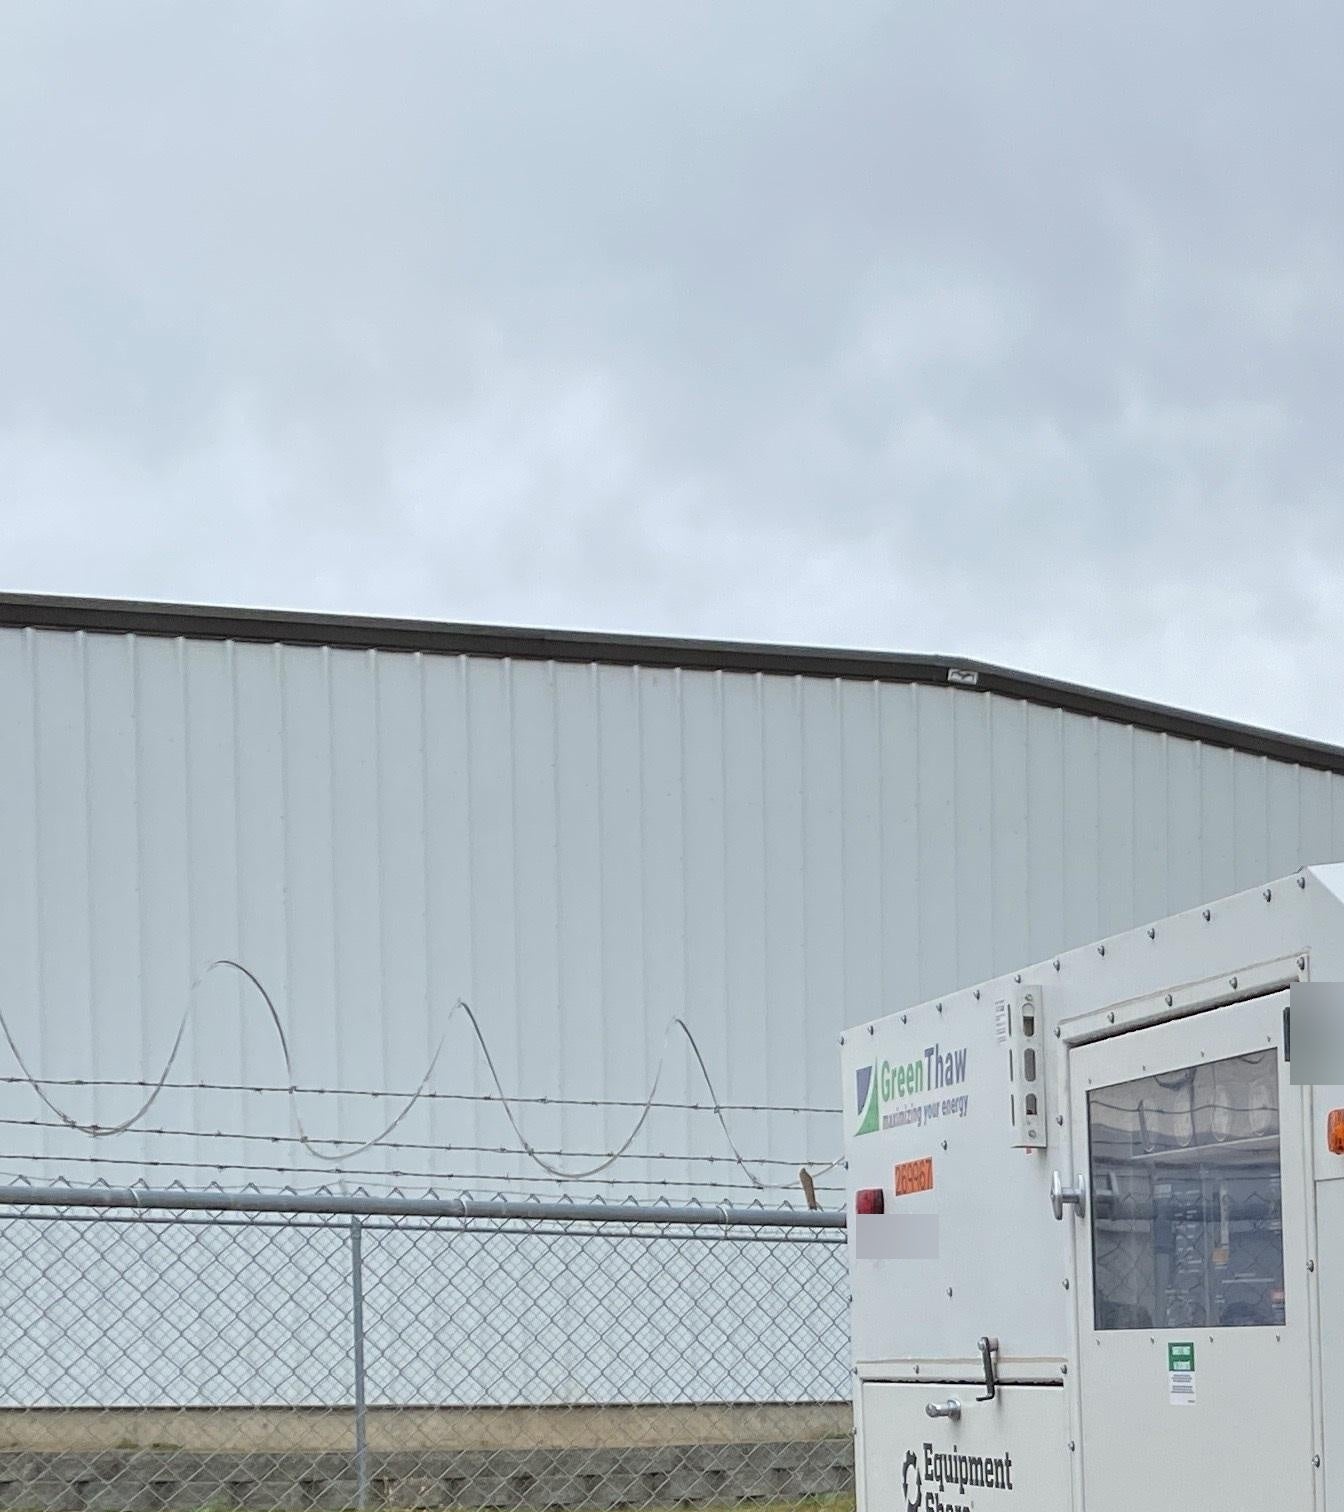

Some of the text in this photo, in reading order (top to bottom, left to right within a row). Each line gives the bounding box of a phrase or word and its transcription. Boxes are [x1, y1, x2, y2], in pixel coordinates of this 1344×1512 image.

[923, 1101, 940, 1126] your
[942, 1095, 969, 1118] energy
[923, 1442, 1014, 1495] Equipment
